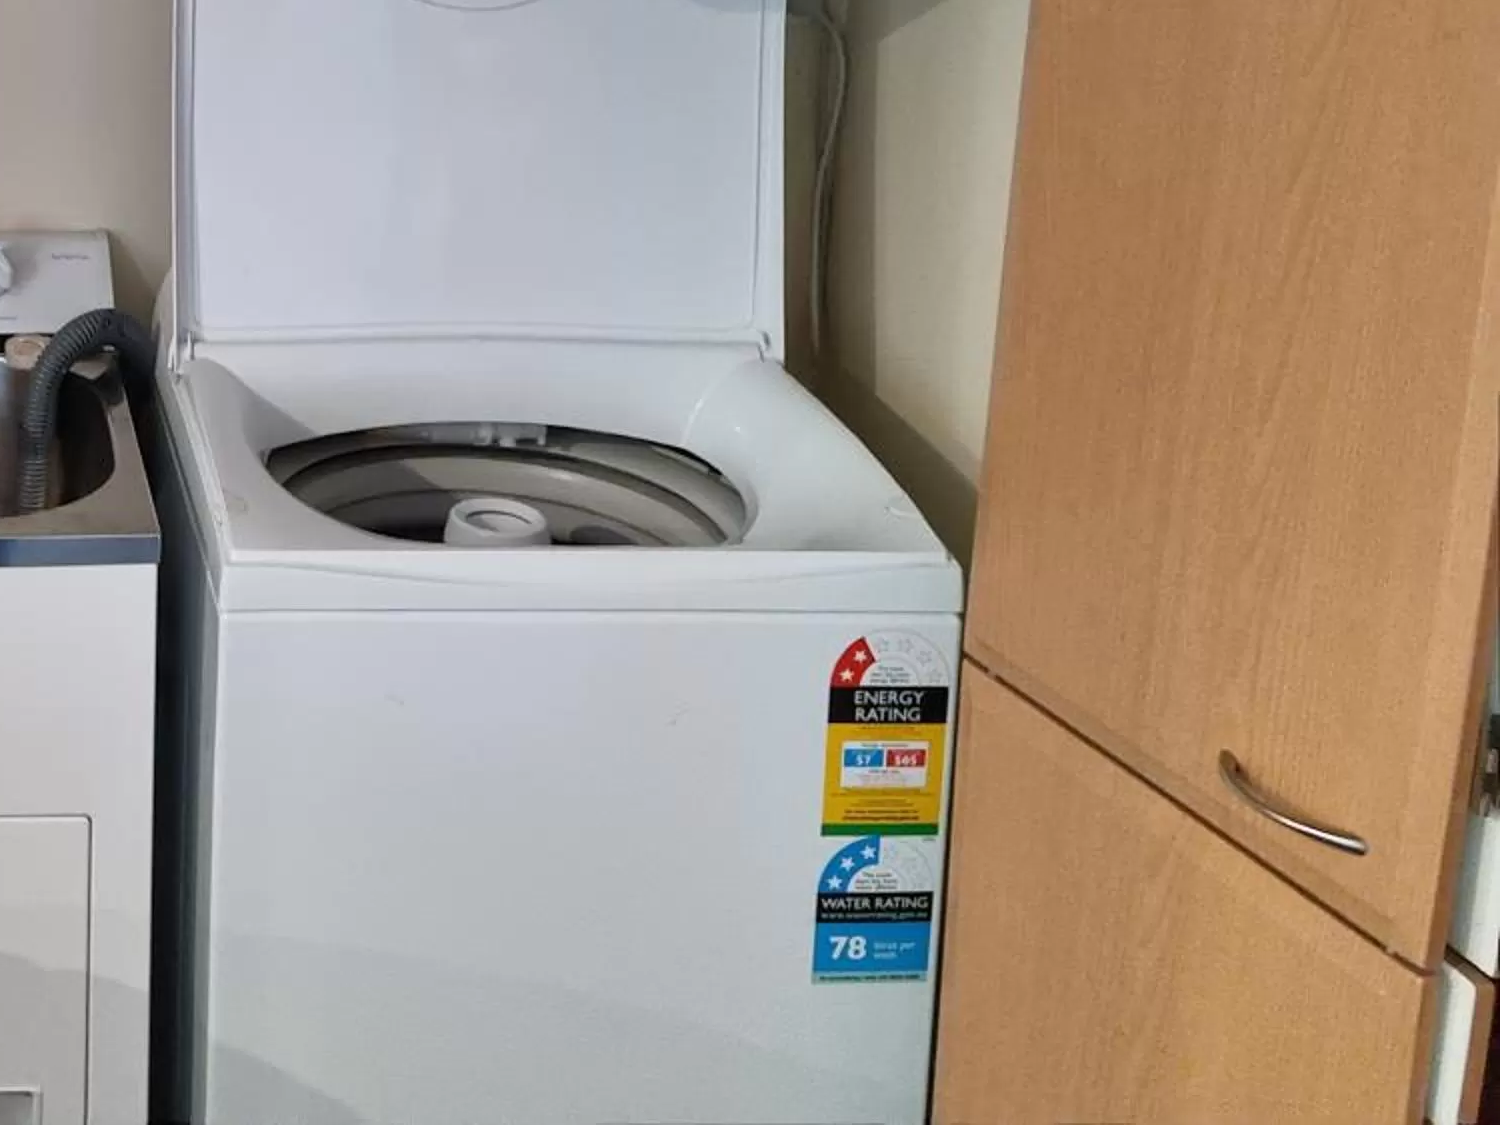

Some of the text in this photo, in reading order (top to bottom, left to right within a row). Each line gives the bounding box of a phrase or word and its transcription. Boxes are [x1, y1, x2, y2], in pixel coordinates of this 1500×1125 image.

[853, 690, 925, 706] ENERGY
[854, 706, 921, 722] RATING
[821, 896, 929, 910] WATER RATING
[829, 935, 867, 961] 78
